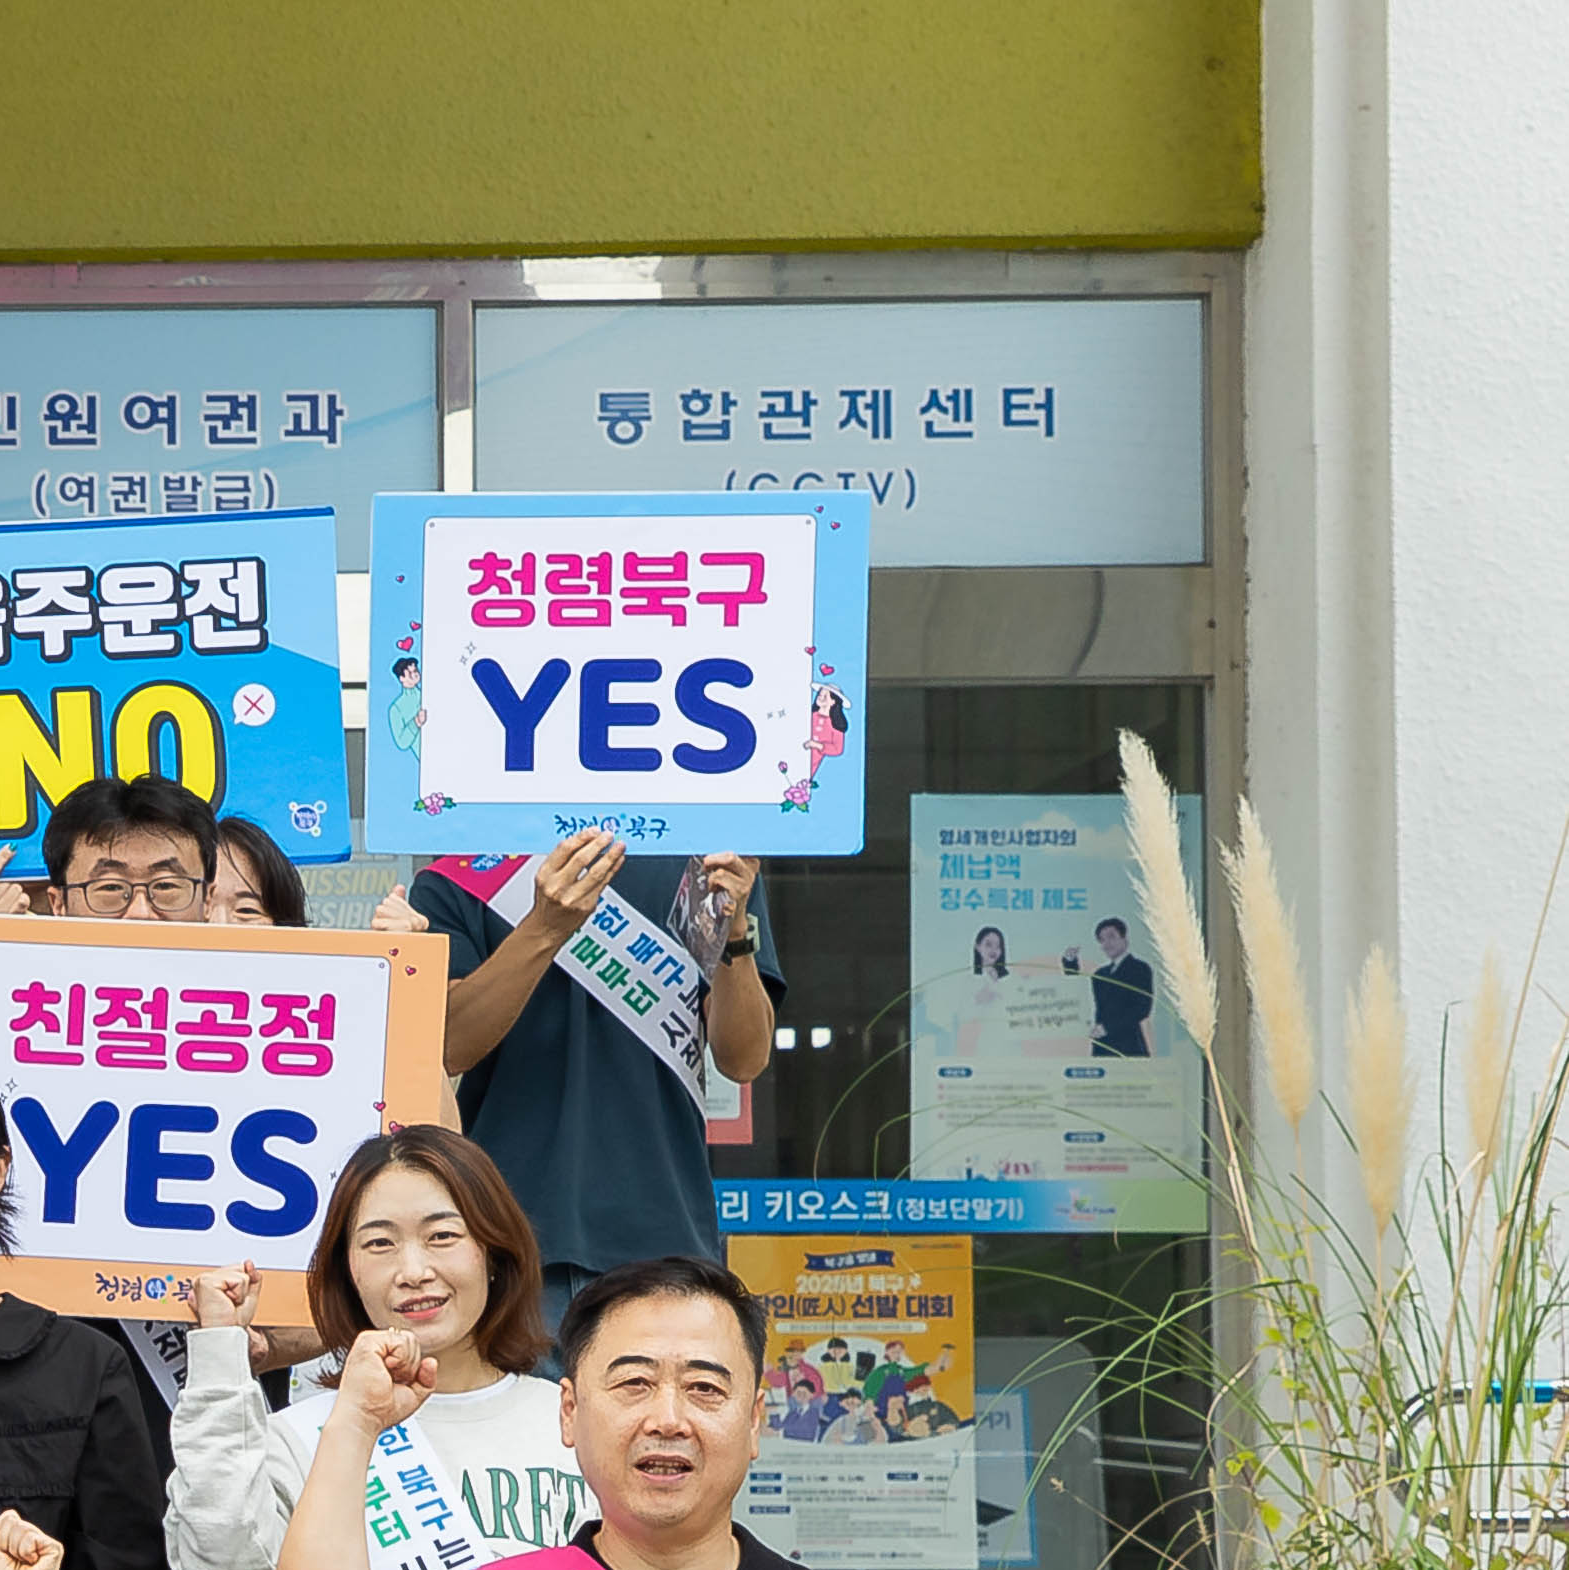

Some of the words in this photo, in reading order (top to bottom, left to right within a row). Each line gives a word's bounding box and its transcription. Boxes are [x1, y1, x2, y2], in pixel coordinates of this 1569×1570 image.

[596, 387, 1057, 444] 통합관제센터
[469, 552, 767, 628] 청렴북구
[471, 658, 756, 774] YES
[564, 927, 660, 1017] 로부터
[10, 981, 336, 1076] 친절공정
[12, 1097, 317, 1236] YES
[721, 1191, 748, 1222] 리
[851, 1295, 899, 1318] 선발
[906, 1295, 953, 1318] 대회
[396, 1463, 474, 1570] 북구는
